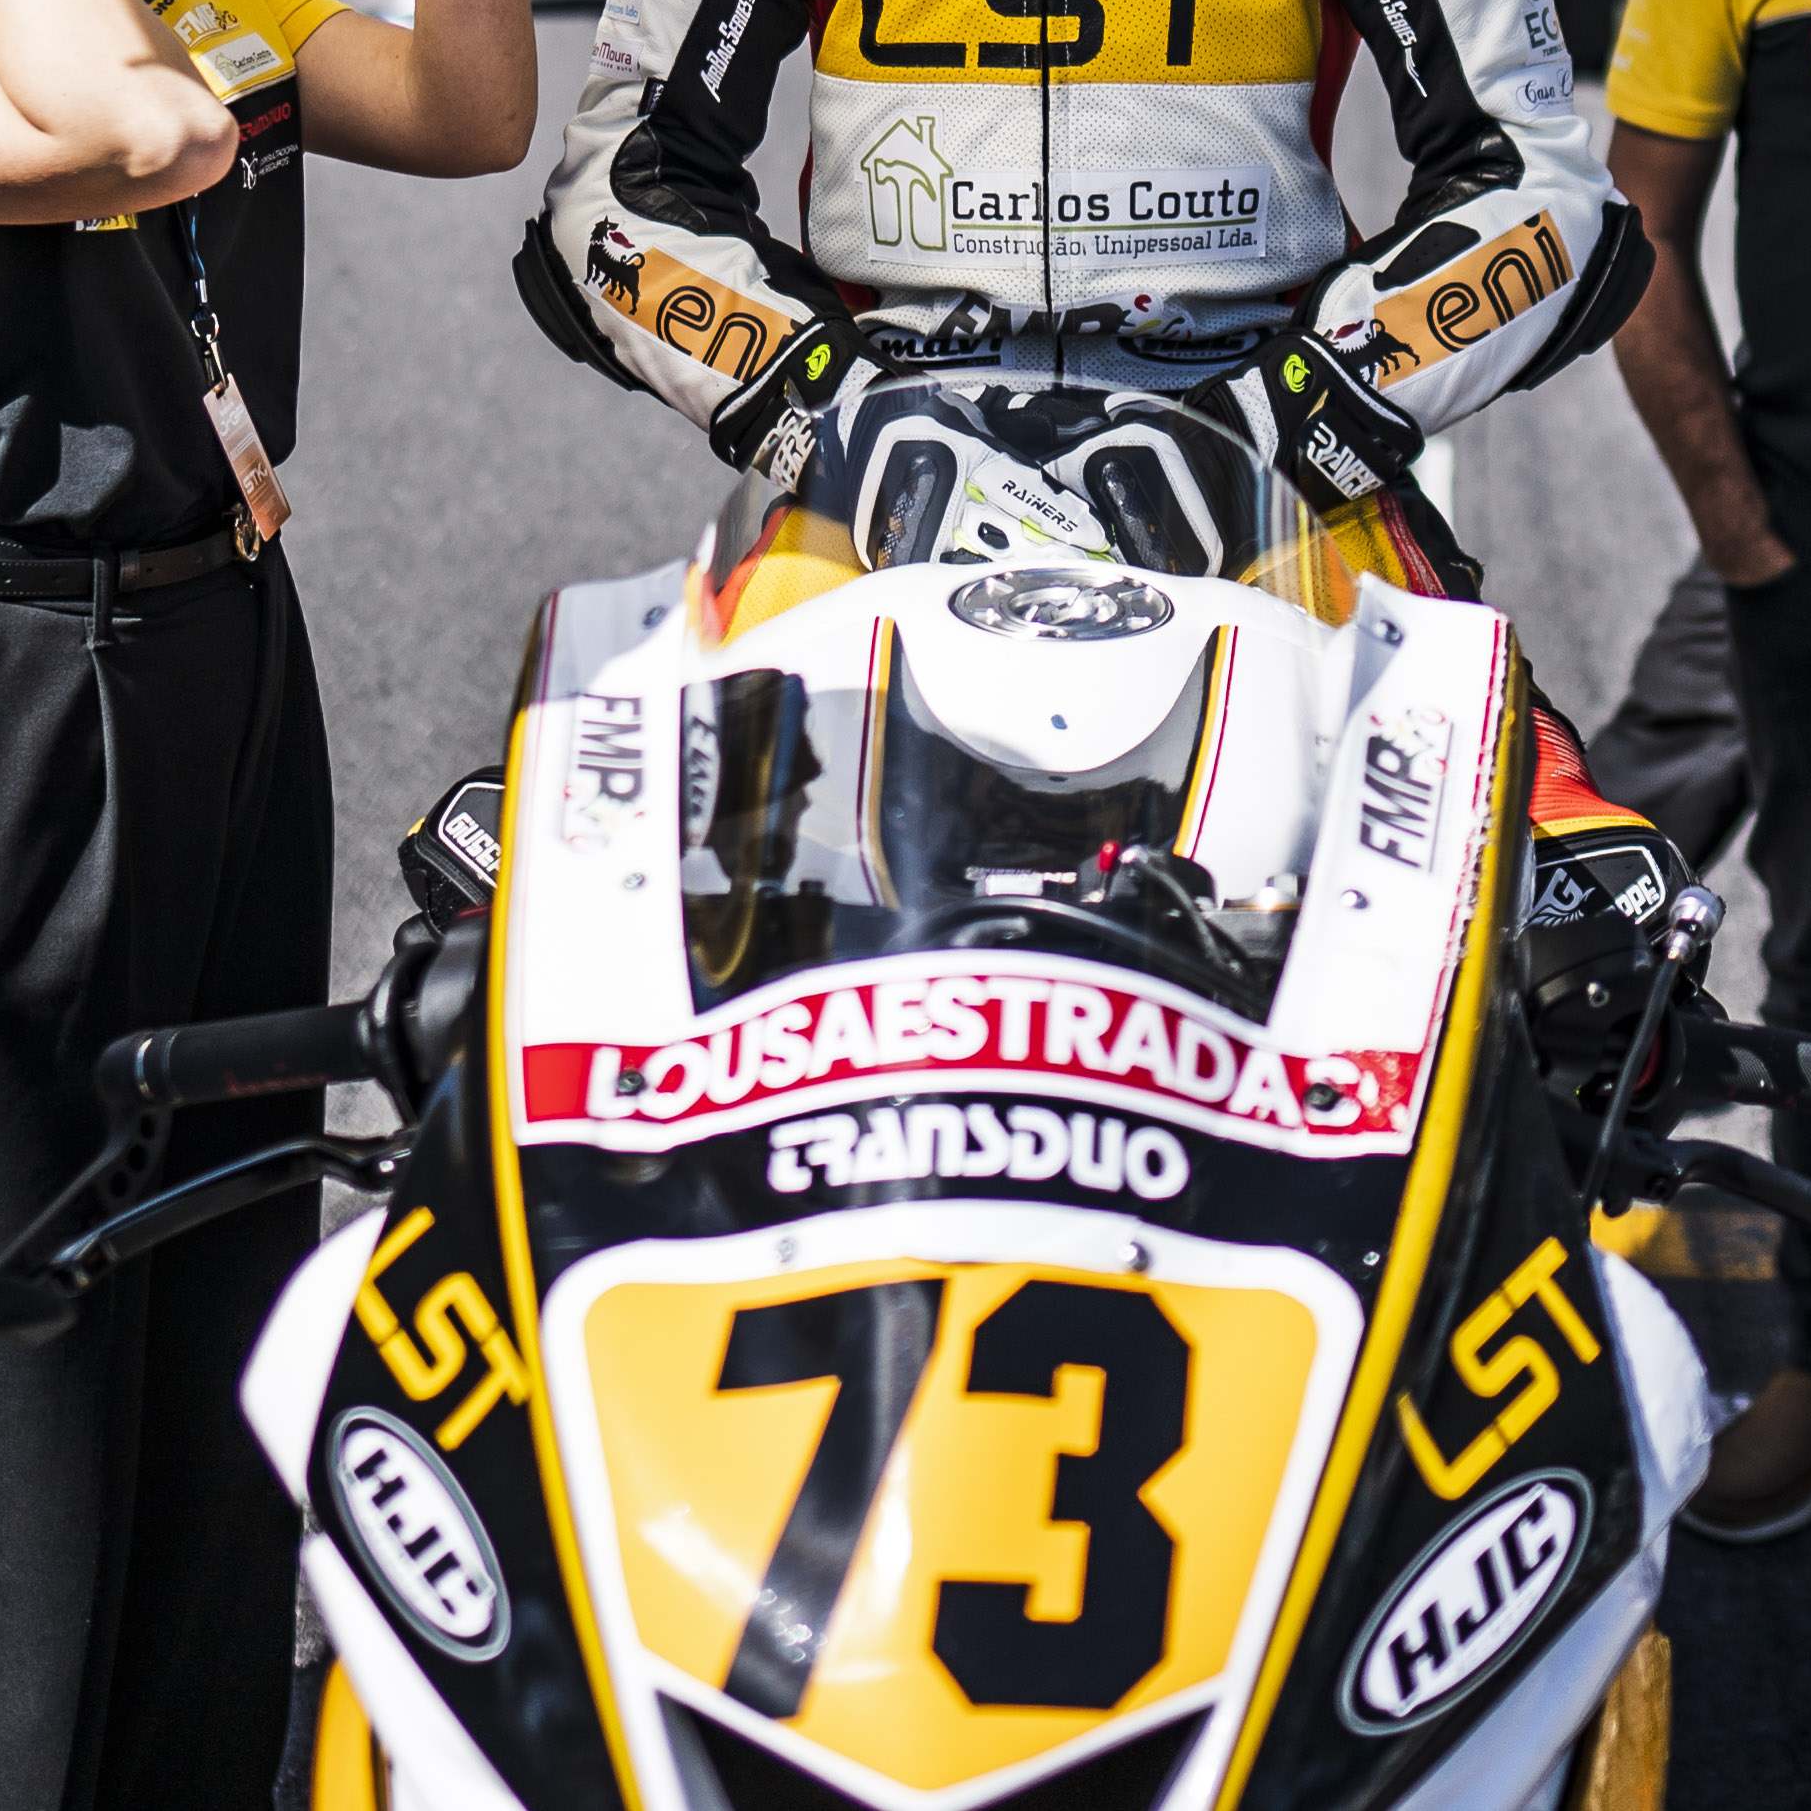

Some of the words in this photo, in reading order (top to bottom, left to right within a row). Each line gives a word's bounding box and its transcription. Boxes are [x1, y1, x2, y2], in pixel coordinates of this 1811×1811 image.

[599, 42, 632, 65] Moura
[951, 180, 1111, 223] Carlos
[1128, 179, 1261, 221] Couto
[1095, 230, 1212, 259] Unipessoal
[1218, 229, 1259, 249] Lda.
[655, 285, 797, 386] en
[1425, 212, 1570, 353] eni
[1002, 479, 1079, 534] RAINERS
[577, 694, 644, 803] FMP
[1359, 733, 1433, 869] FMP
[352, 1205, 533, 1451] LST
[1396, 1235, 1601, 1501] LST
[354, 1448, 486, 1616] HJC
[715, 1277, 1196, 1719] 73
[1388, 1494, 1559, 1700] HJC
